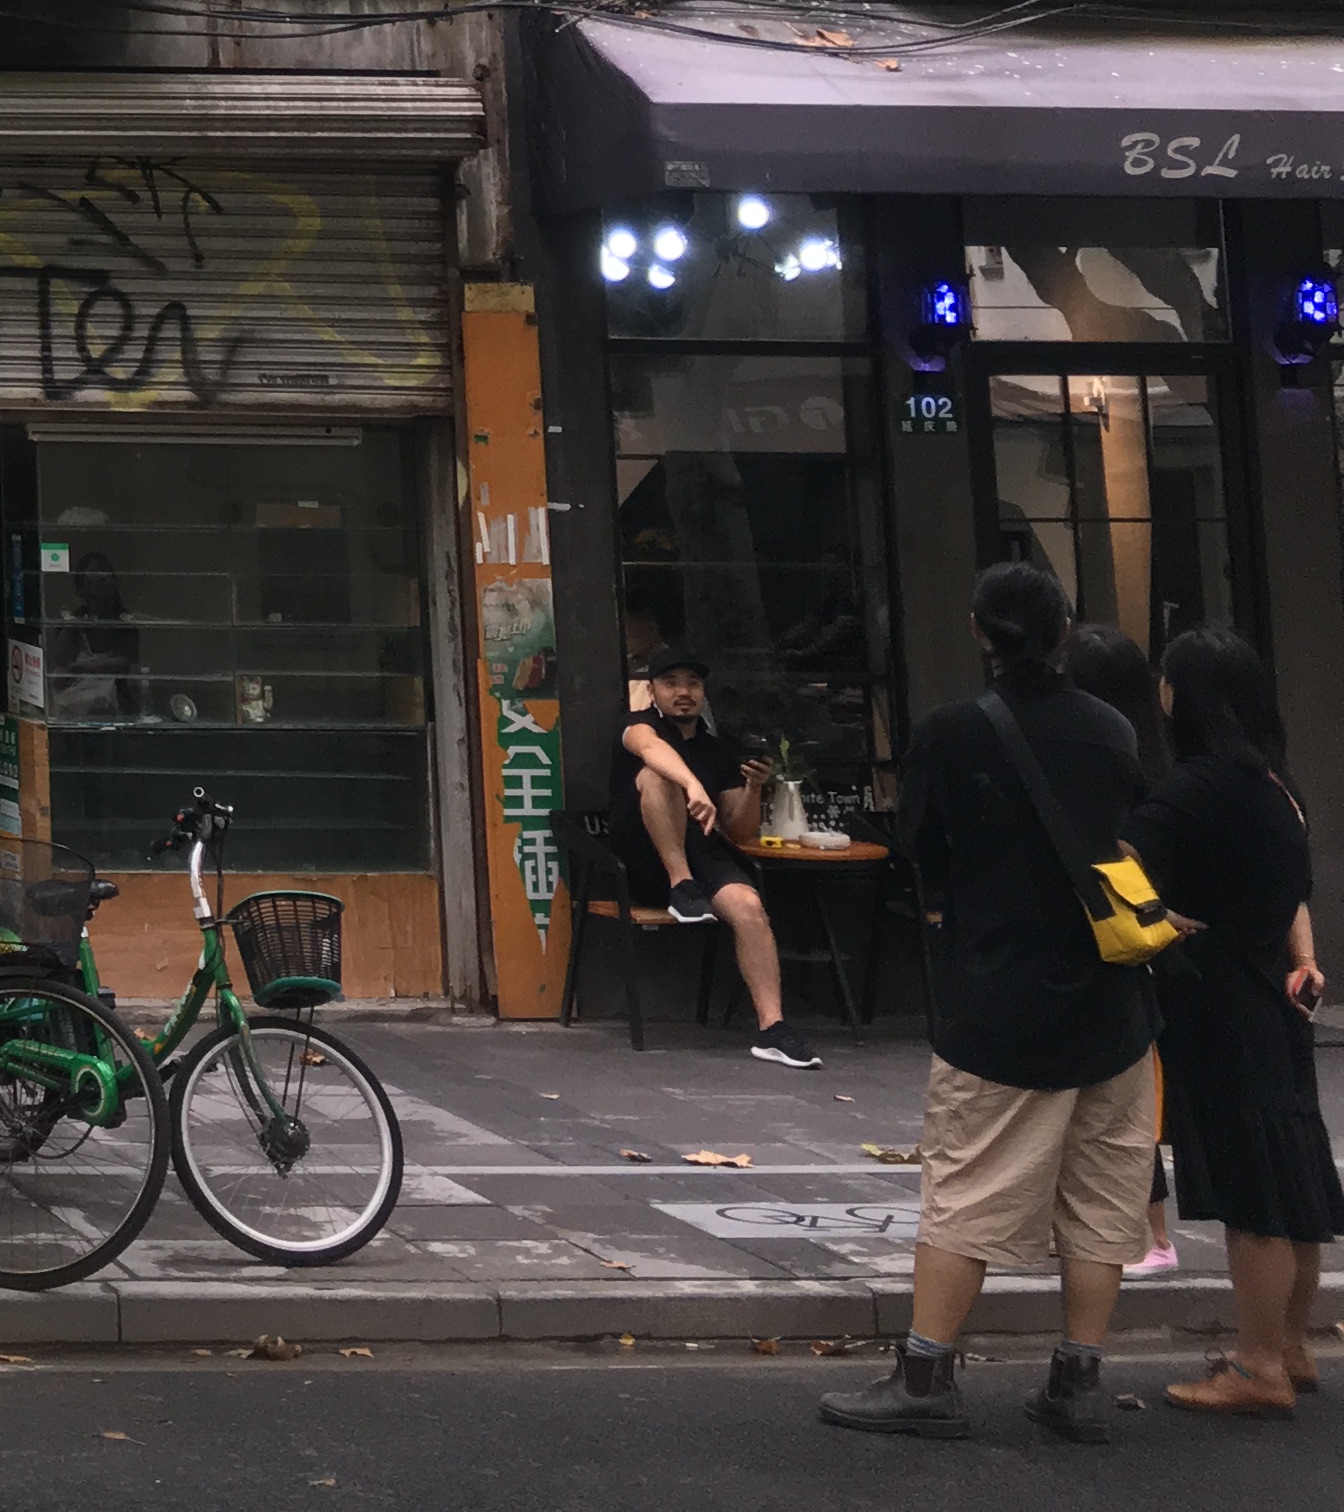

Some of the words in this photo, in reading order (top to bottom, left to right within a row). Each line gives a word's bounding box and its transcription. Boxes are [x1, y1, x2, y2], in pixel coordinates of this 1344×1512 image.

[1120, 132, 1241, 179] BSL
[1266, 153, 1333, 180] Hair
[903, 396, 954, 419] 102
